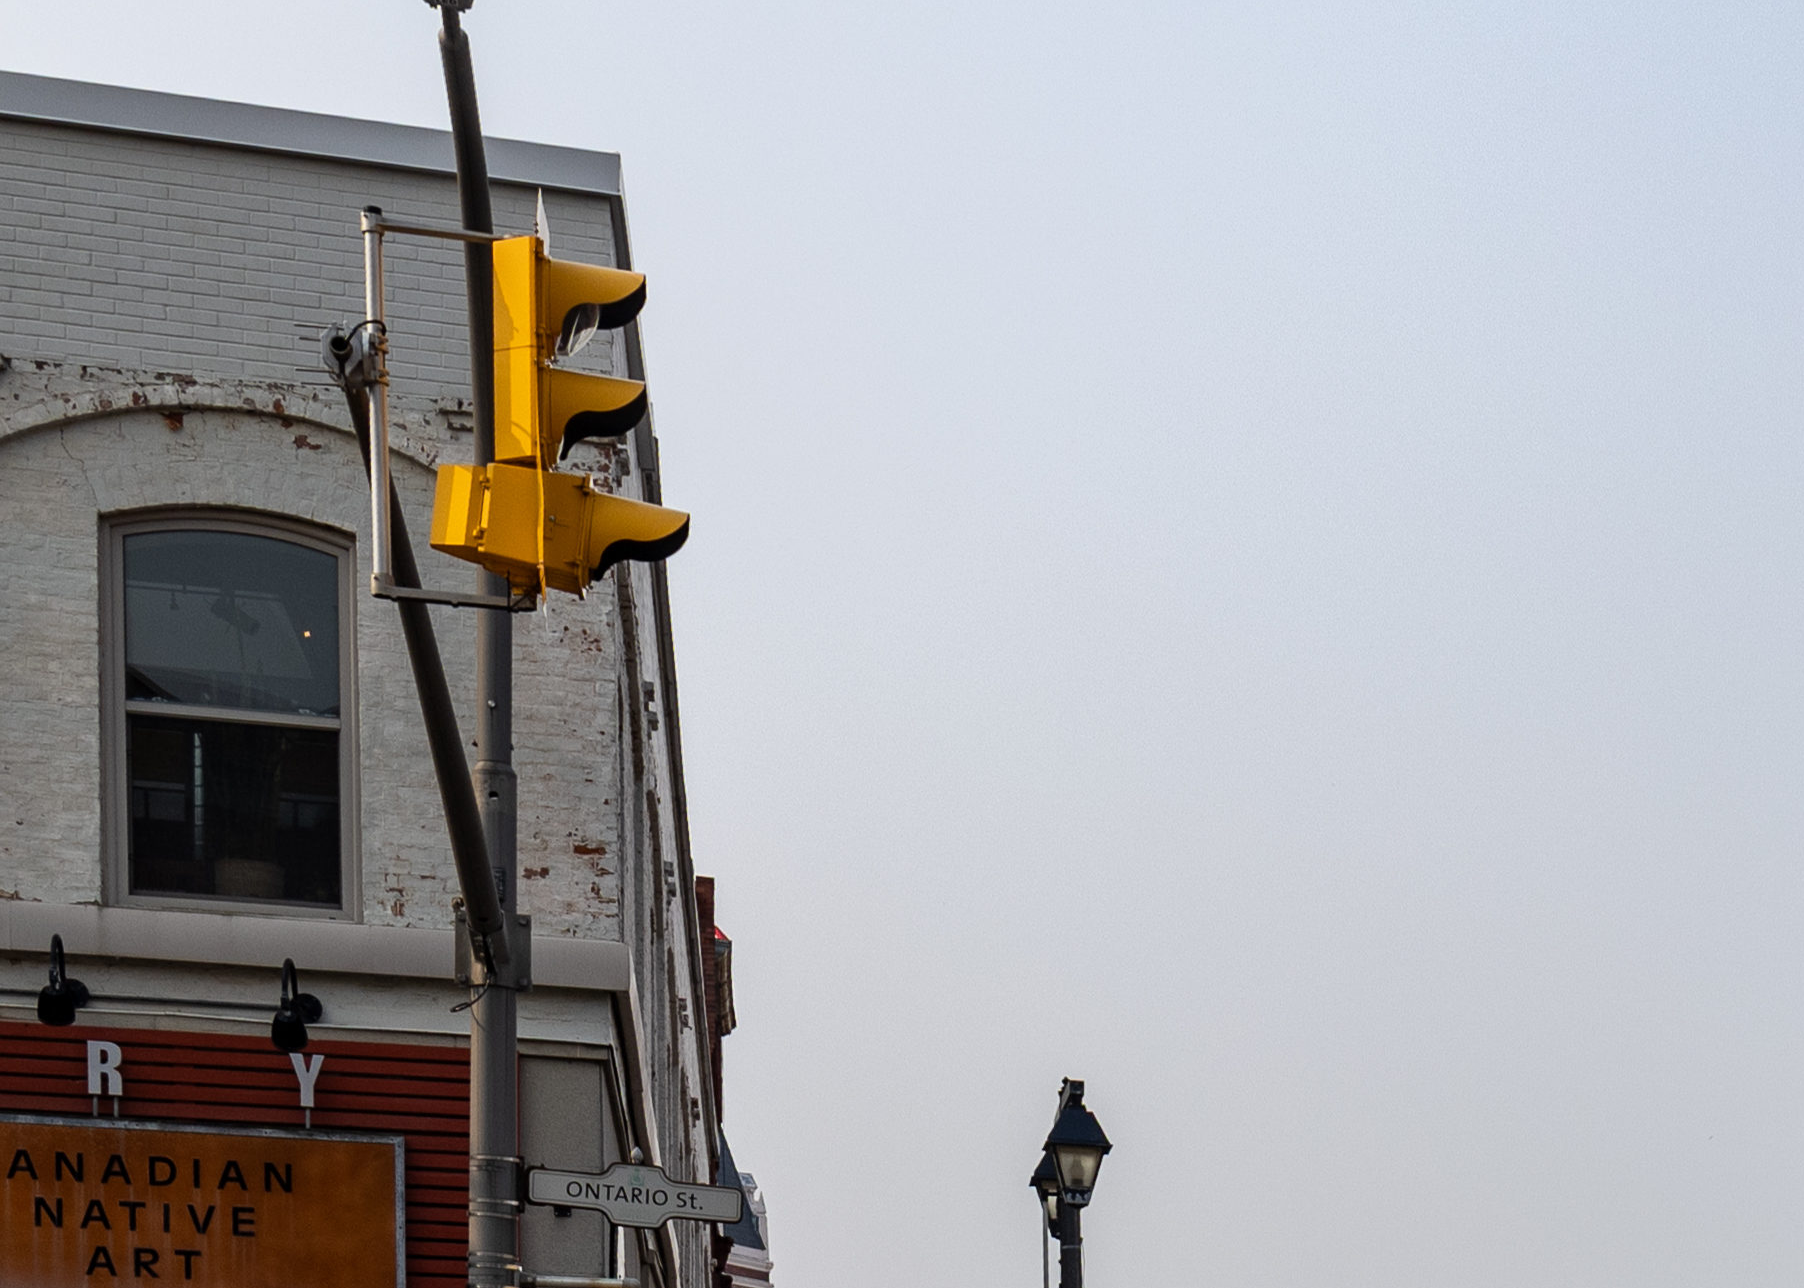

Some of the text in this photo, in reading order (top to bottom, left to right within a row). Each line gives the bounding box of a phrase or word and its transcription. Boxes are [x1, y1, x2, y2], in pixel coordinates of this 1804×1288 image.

[6, 1149, 293, 1193] ANADIAN
[566, 1181, 704, 1211] ONTARIO St.
[34, 1196, 256, 1237] NATIVE
[86, 1245, 202, 1280] ART
